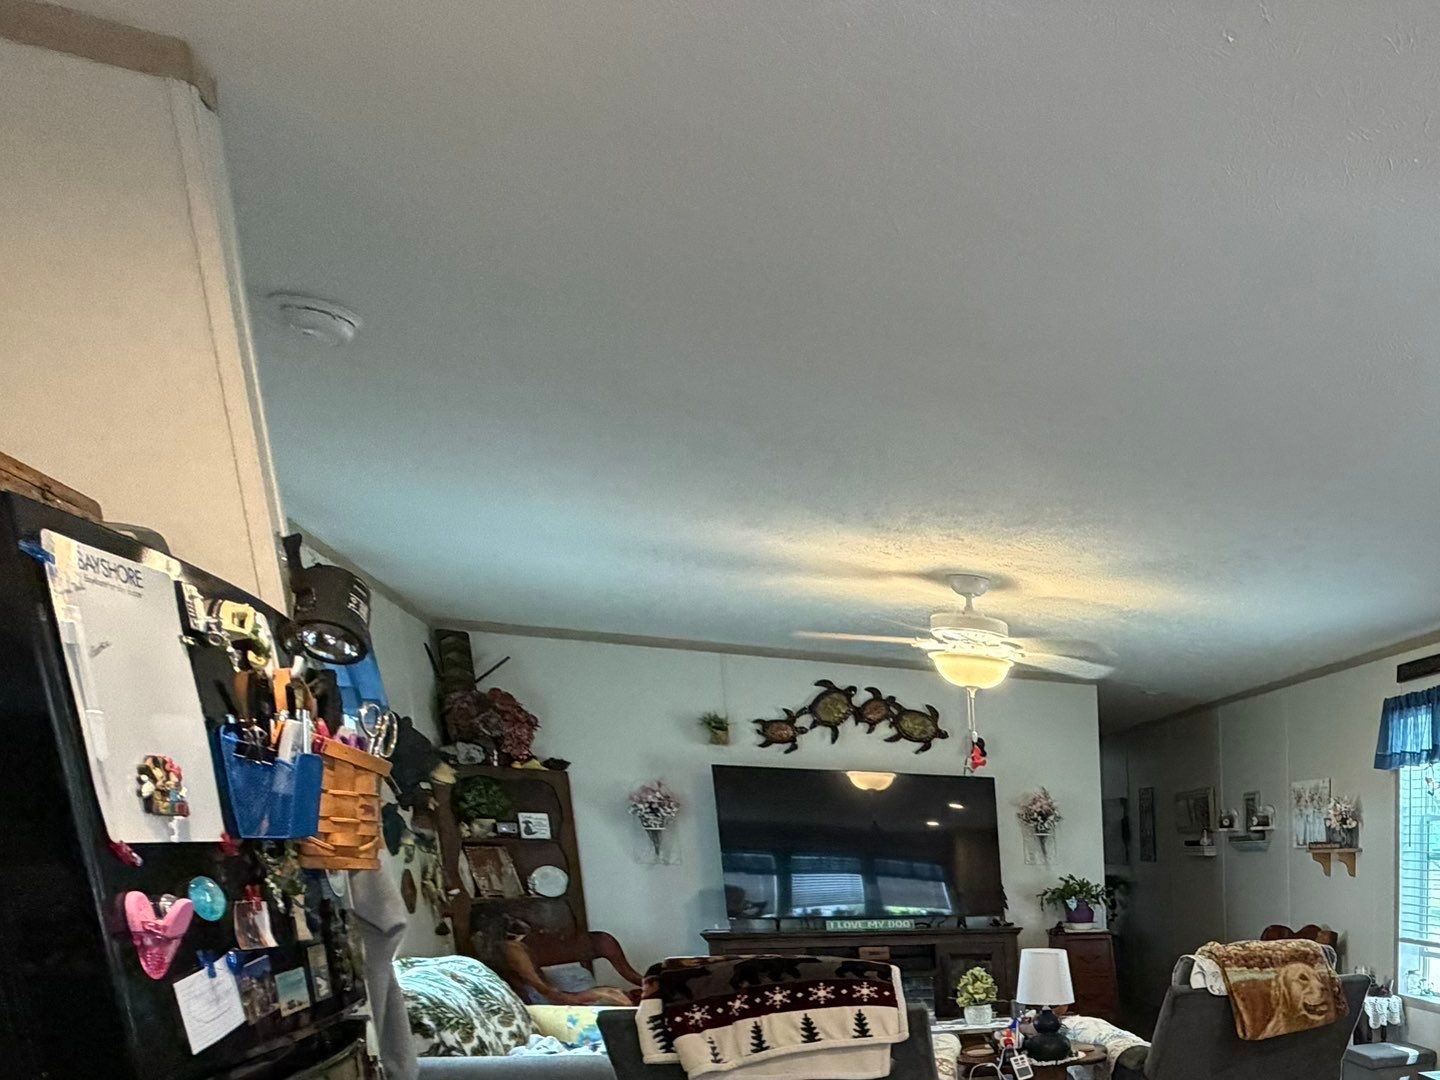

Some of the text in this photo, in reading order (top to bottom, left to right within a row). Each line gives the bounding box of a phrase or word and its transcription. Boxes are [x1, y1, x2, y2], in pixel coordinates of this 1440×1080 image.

[837, 920, 863, 929] LOVE
[867, 920, 884, 929] MY
[888, 919, 911, 929] DOG
